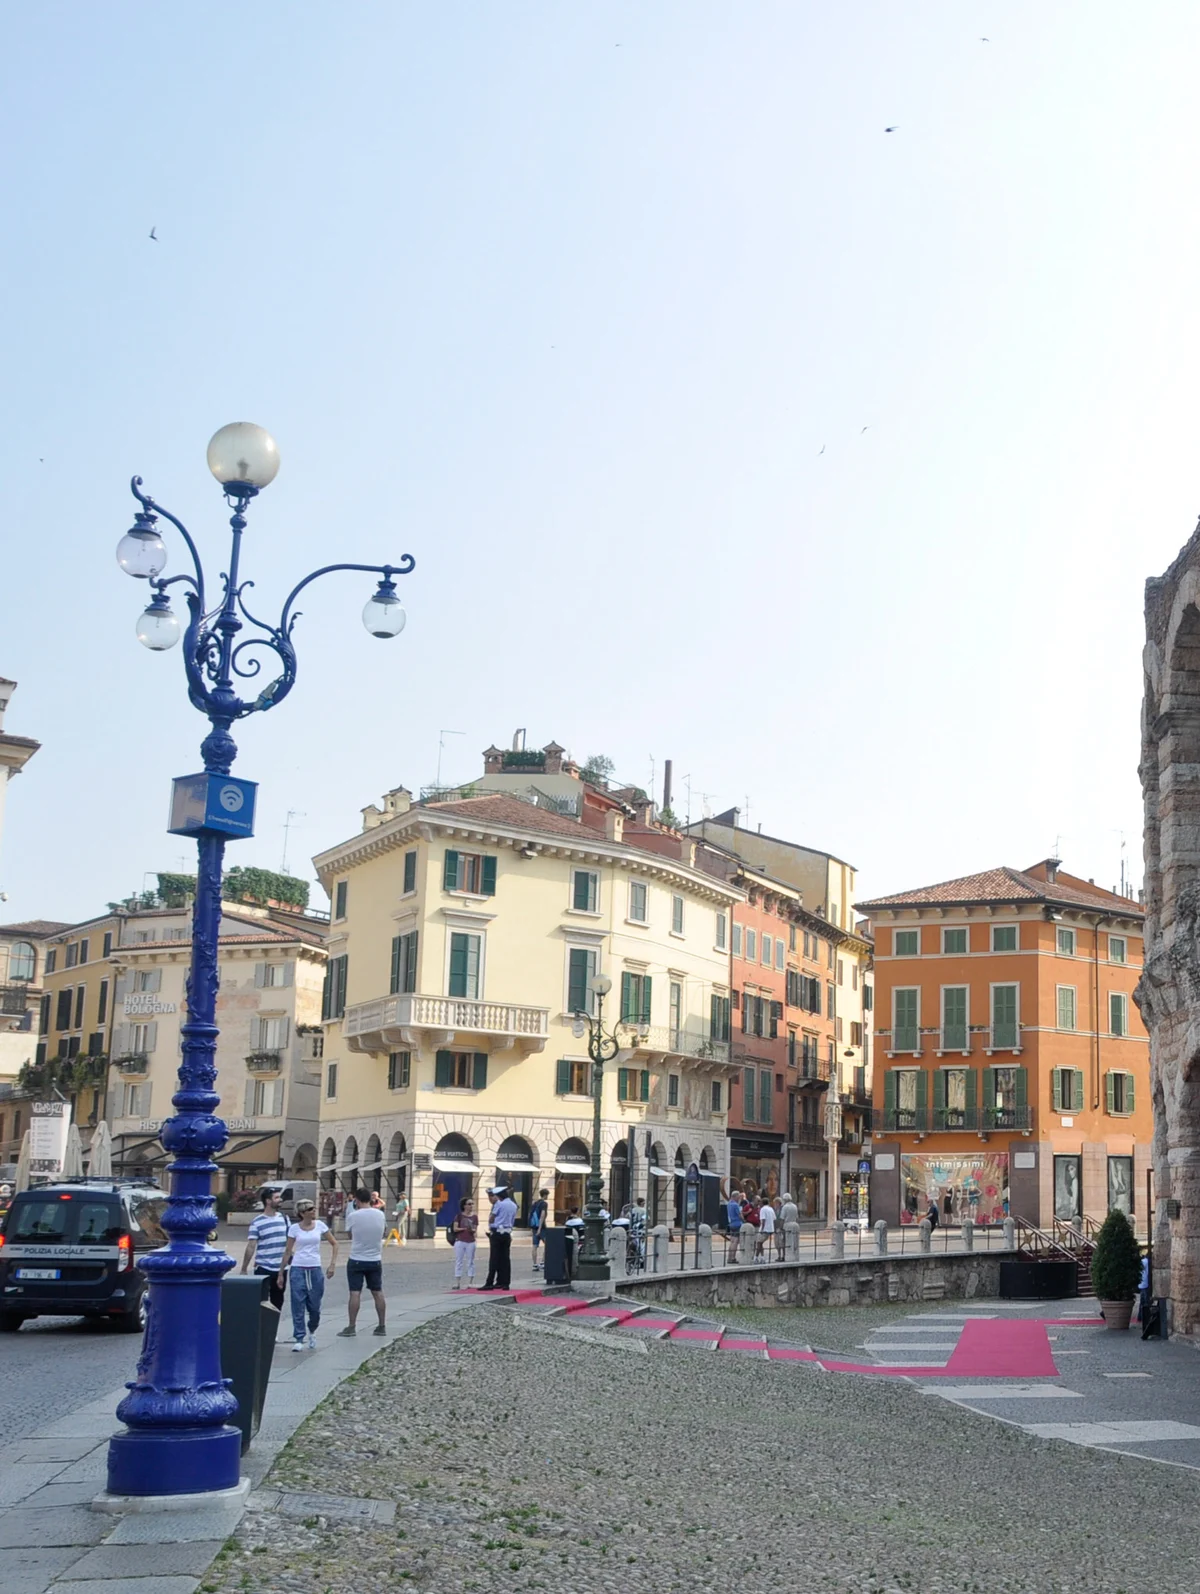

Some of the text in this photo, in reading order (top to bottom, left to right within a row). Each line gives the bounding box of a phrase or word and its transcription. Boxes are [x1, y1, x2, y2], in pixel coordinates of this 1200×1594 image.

[124, 994, 160, 1004] HOTEL
[124, 1003, 176, 1014] BOLOGNA
[230, 1120, 256, 1130] BIANI
[926, 1158, 984, 1168] intimissimi
